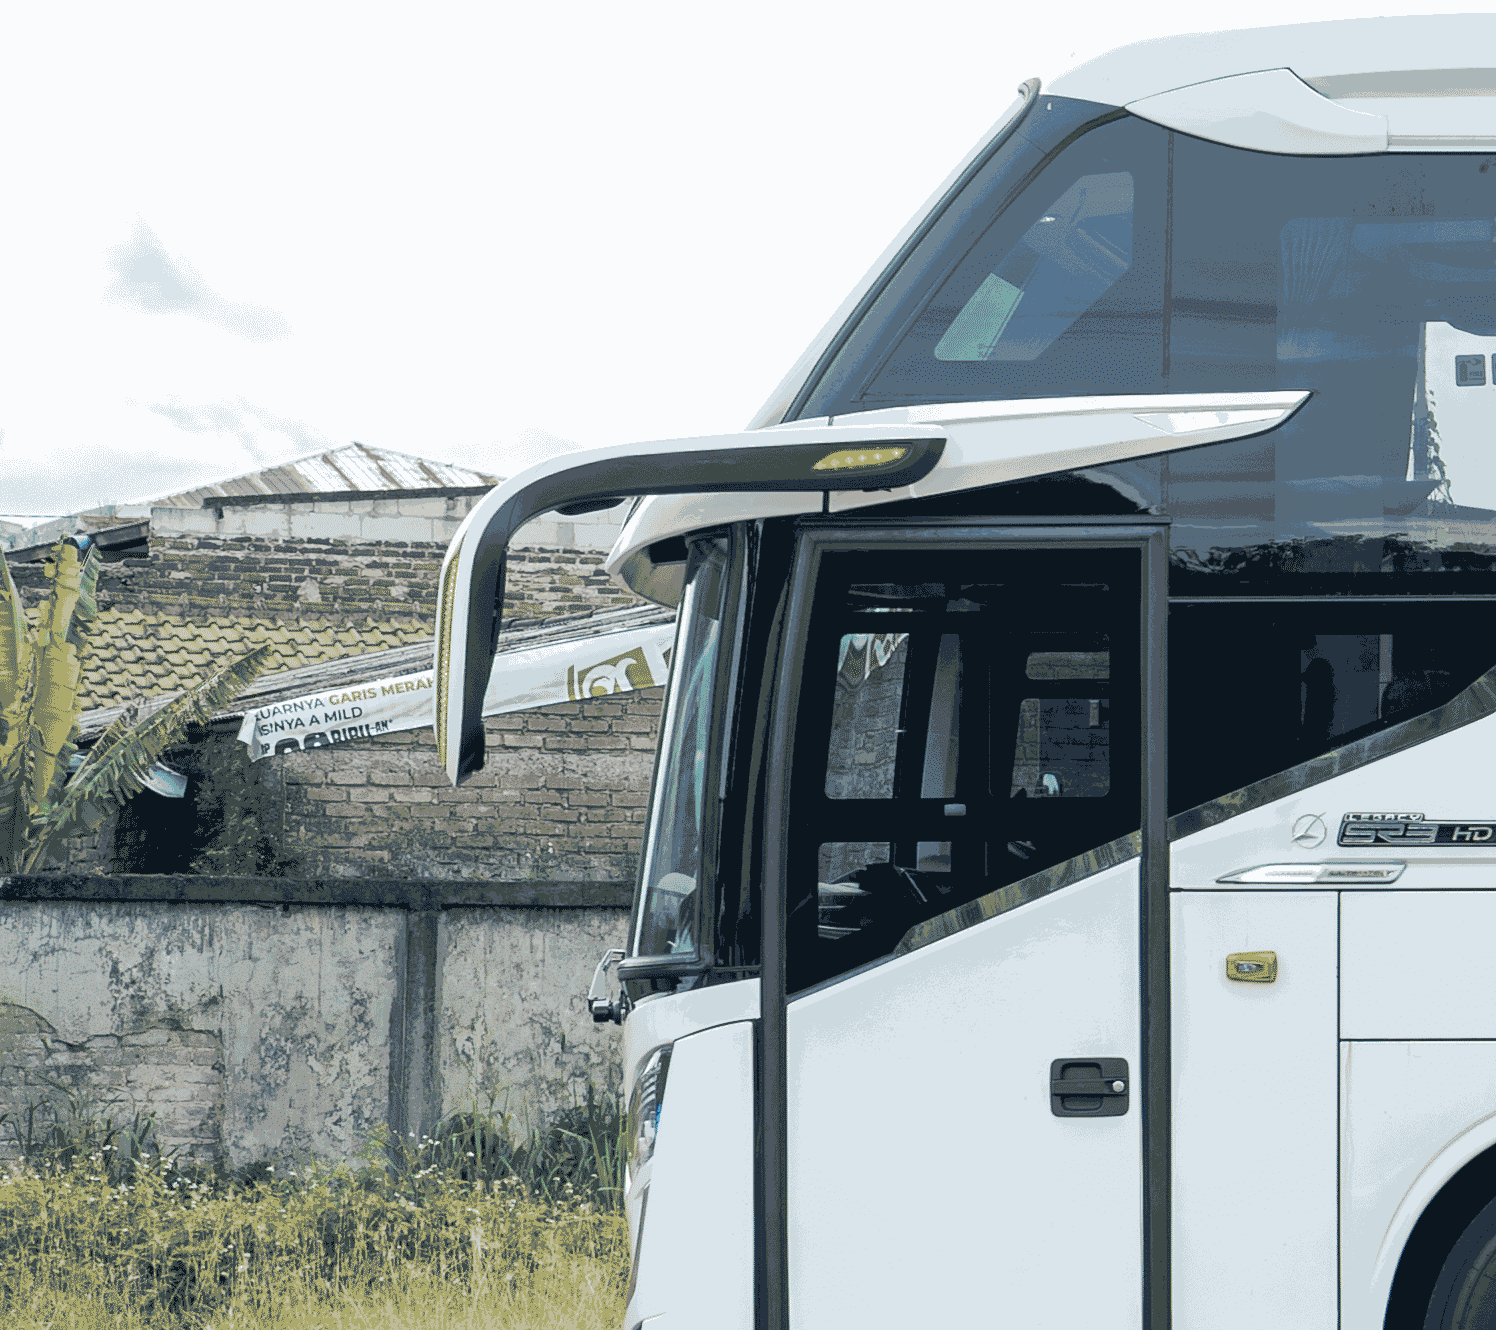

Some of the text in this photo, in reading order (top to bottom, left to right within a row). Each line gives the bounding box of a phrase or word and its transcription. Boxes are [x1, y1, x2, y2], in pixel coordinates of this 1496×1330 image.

[329, 687, 378, 706] GARIS
[308, 714, 321, 727] A
[324, 706, 363, 724] MILD
[1452, 826, 1493, 841] HD
